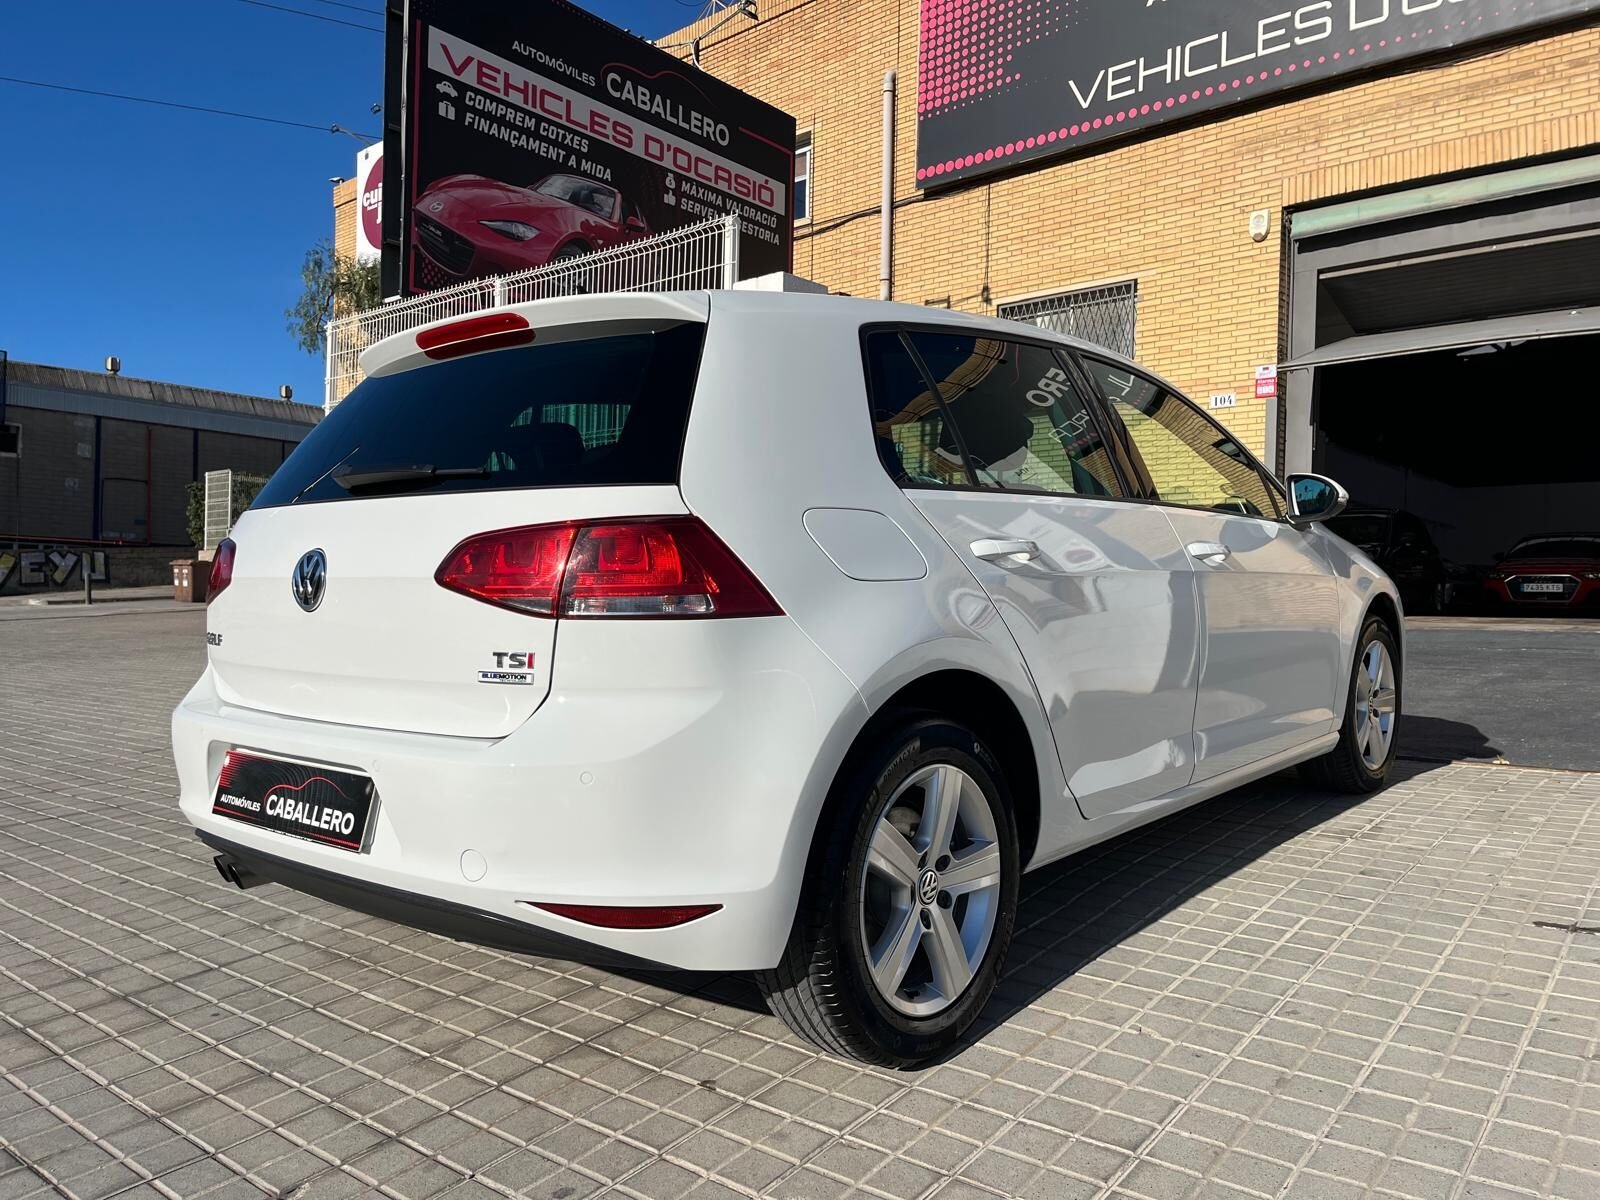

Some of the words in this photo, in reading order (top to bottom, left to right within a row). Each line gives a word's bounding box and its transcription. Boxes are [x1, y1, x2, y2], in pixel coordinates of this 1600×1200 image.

[1068, 0, 1333, 109] VEHICLES
[511, 40, 596, 87] AUTOMÓVILES
[606, 72, 730, 147] CABALLERO
[440, 42, 634, 149] VEHICLES
[644, 133, 775, 208] D'OCASIÓ
[465, 91, 536, 131] COMPREM
[539, 121, 589, 153] COTXES
[464, 112, 567, 163] FINANÇAMENT
[568, 154, 577, 169] A
[580, 159, 612, 182] MIDA
[681, 180, 723, 207] MÀXIMA
[726, 198, 777, 228] VALORACIÓ
[738, 219, 780, 246] ESTORIA
[1214, 395, 1232, 407] 104
[481, 673, 527, 681] BLUEMOTION
[492, 651, 535, 669] TSI
[220, 793, 261, 812] AUTOMÓVILES
[265, 794, 355, 835] CABALLERO
